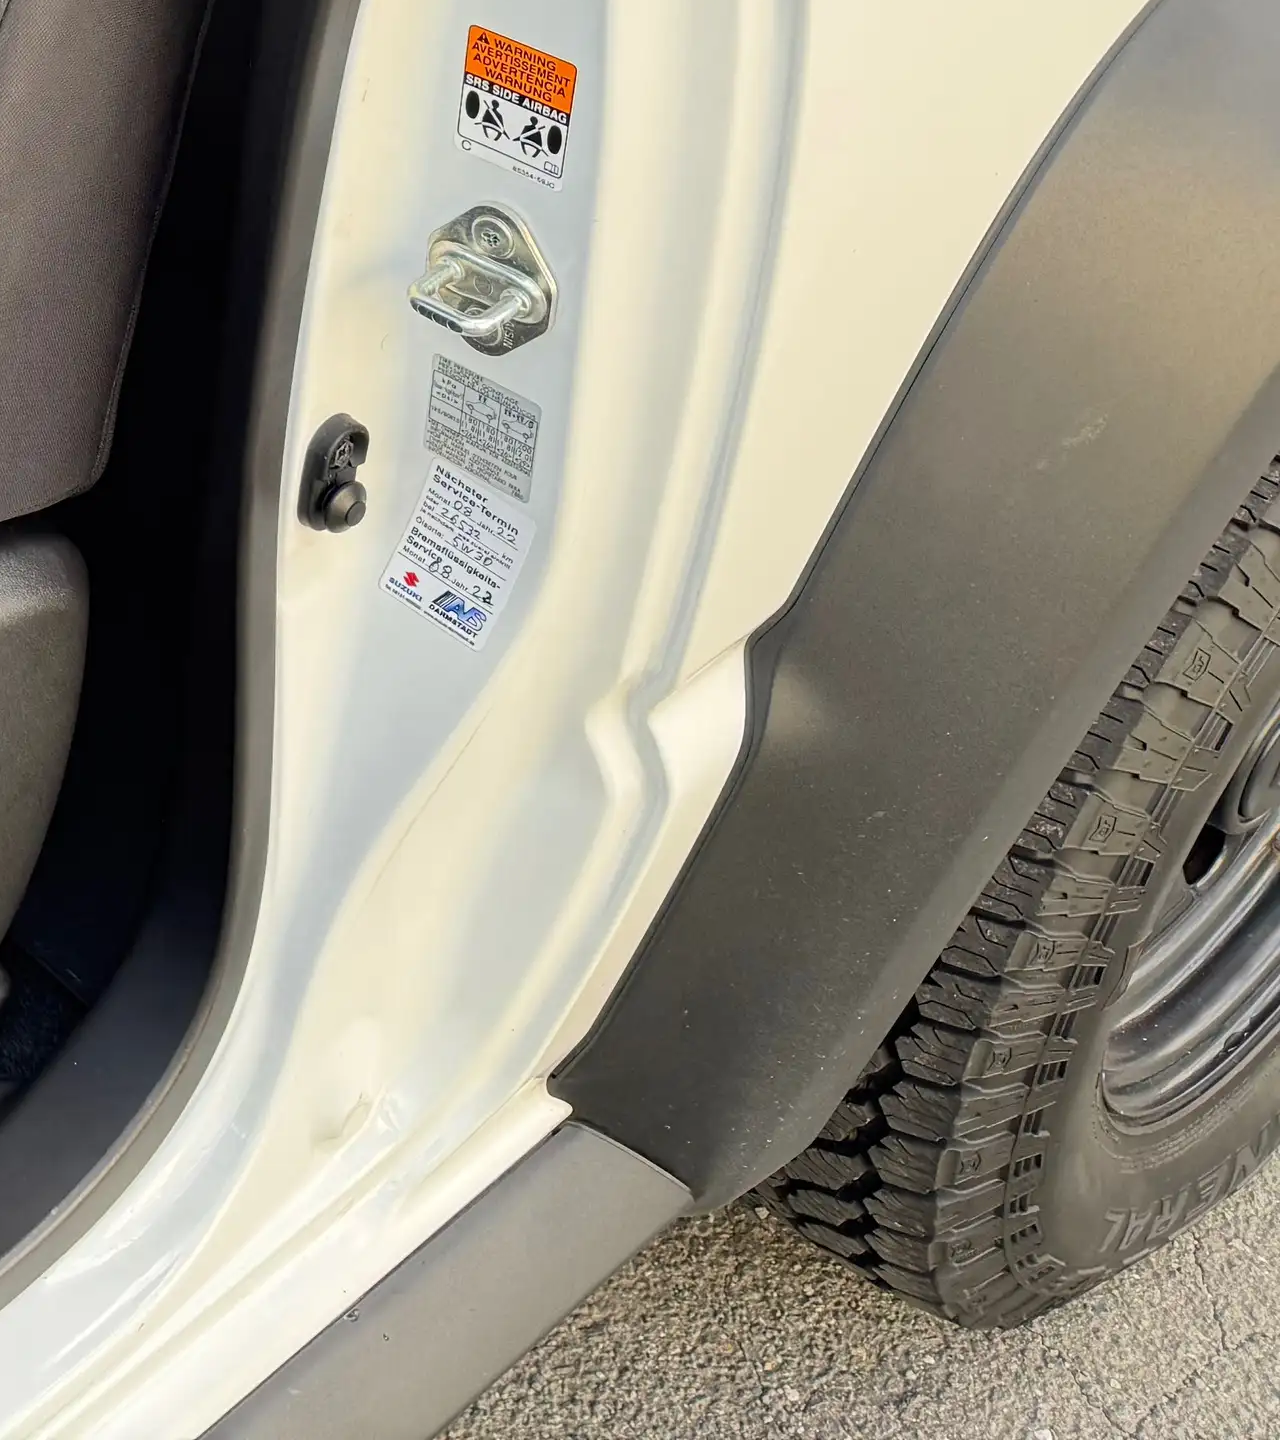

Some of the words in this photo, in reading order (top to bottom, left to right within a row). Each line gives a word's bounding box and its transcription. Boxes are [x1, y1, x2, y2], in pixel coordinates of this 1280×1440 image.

[472, 40, 569, 88] AVERTISSEMENT
[493, 38, 556, 71] WARNING
[473, 51, 565, 98] ADVERTENCIA
[484, 66, 552, 103] WARNUNG
[465, 73, 489, 91] SRS
[492, 84, 519, 104] SIDE
[522, 96, 567, 124] AIRBAG
[461, 139, 472, 151] C
[427, 487, 451, 505] Monat
[434, 464, 489, 503] Nächster
[430, 473, 521, 535] Service-Termin
[401, 544, 425, 563] Monat
[405, 535, 443, 564] Service
[409, 526, 502, 592] Bremsflüssigkeits-
[388, 576, 422, 602] SUZUKI
[428, 603, 477, 639] DARMSTADT
